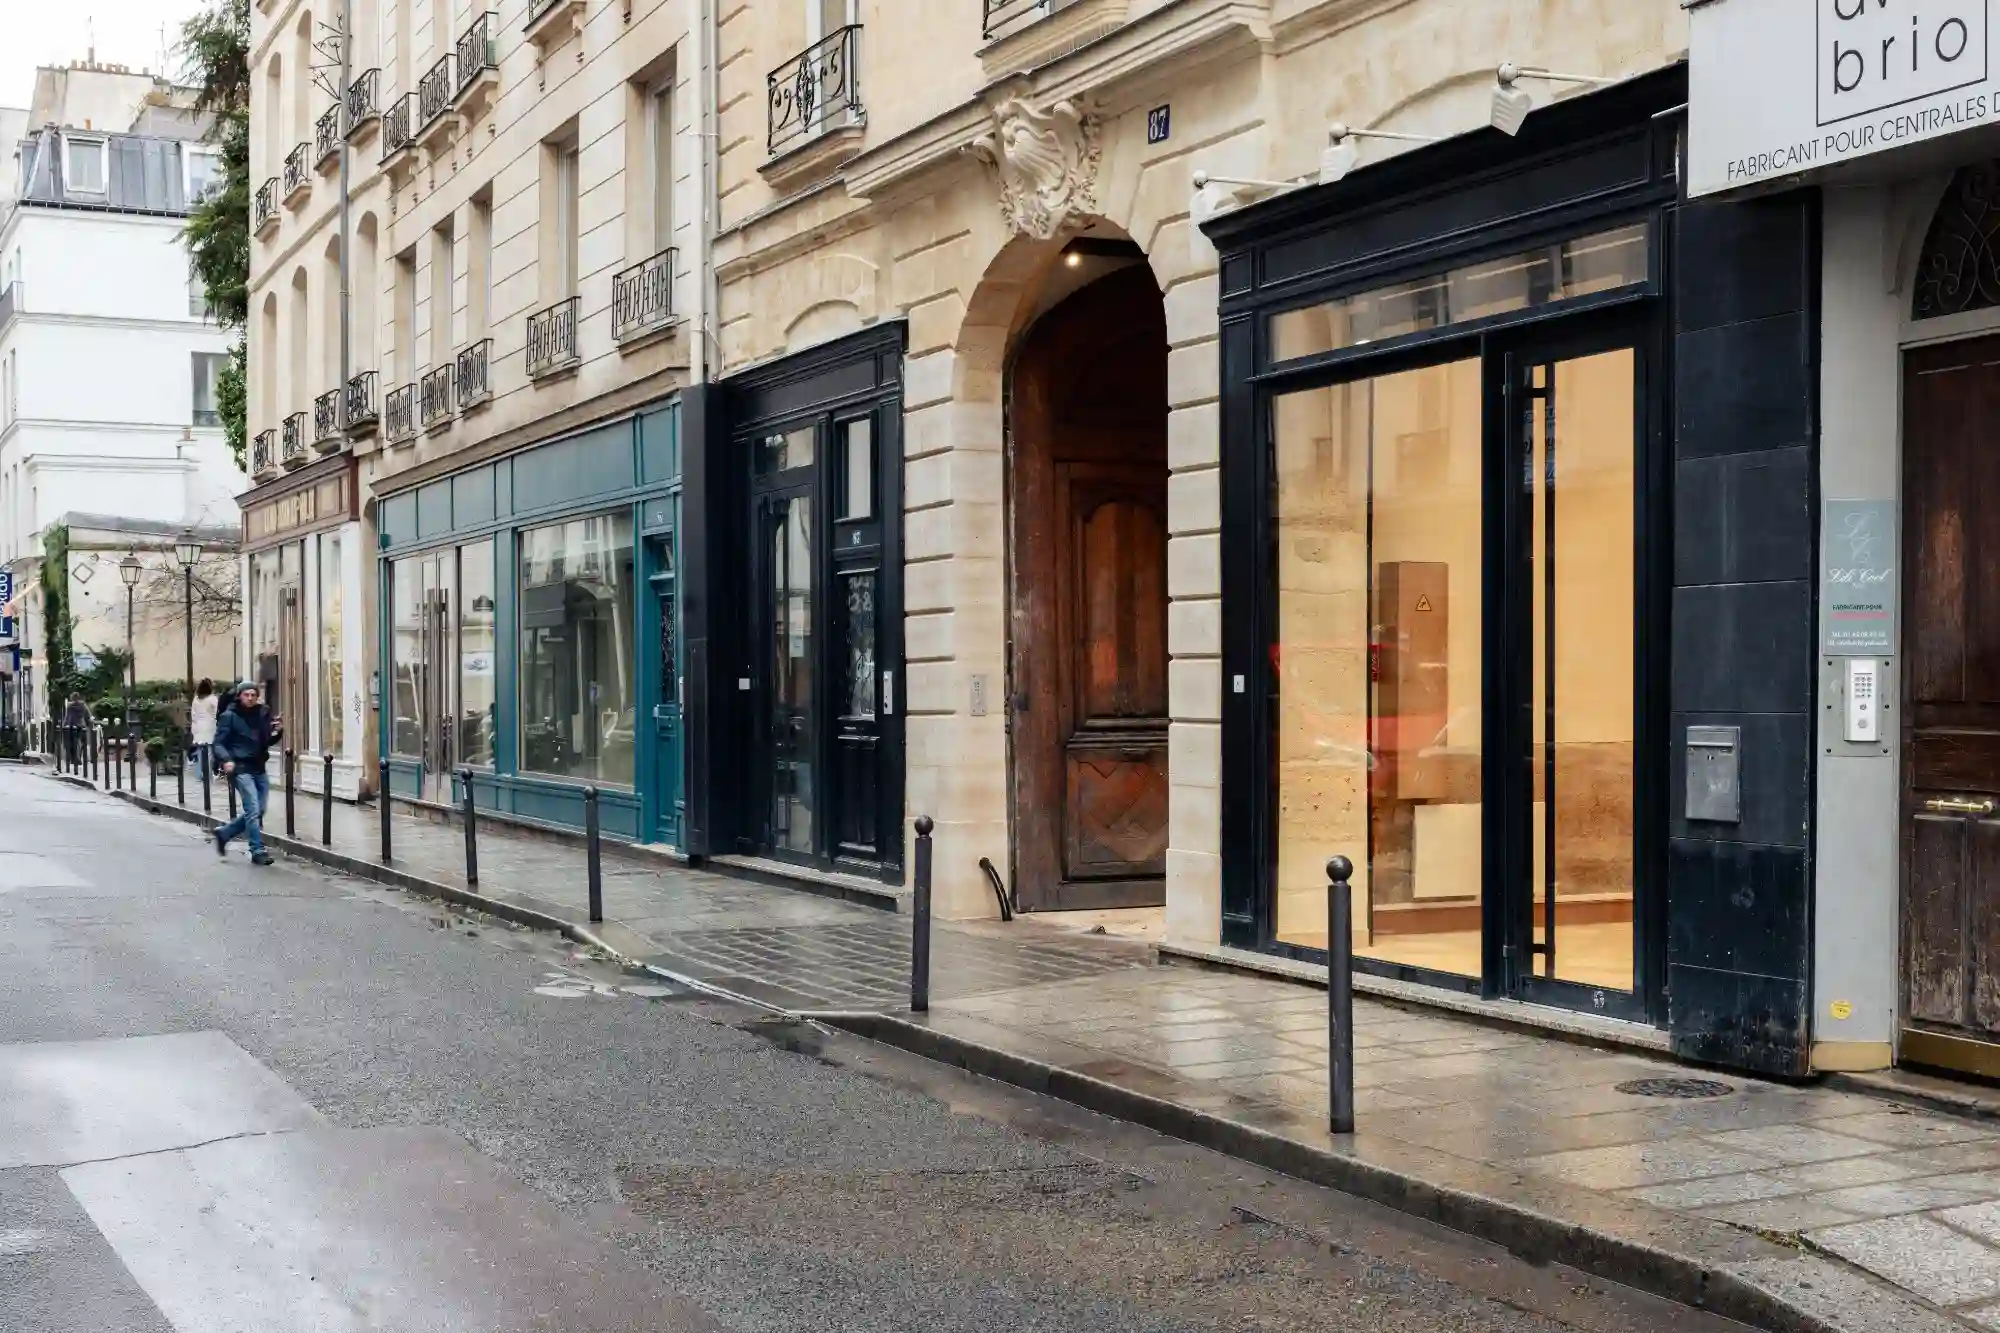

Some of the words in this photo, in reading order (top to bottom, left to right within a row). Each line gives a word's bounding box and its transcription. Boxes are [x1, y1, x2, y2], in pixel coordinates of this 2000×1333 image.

[1834, 15, 1967, 94] brio
[1150, 108, 1167, 140] 87
[1727, 138, 1820, 182] FABRICANT
[1824, 124, 1875, 157] POUR
[1879, 95, 1987, 142] CENTRALES
